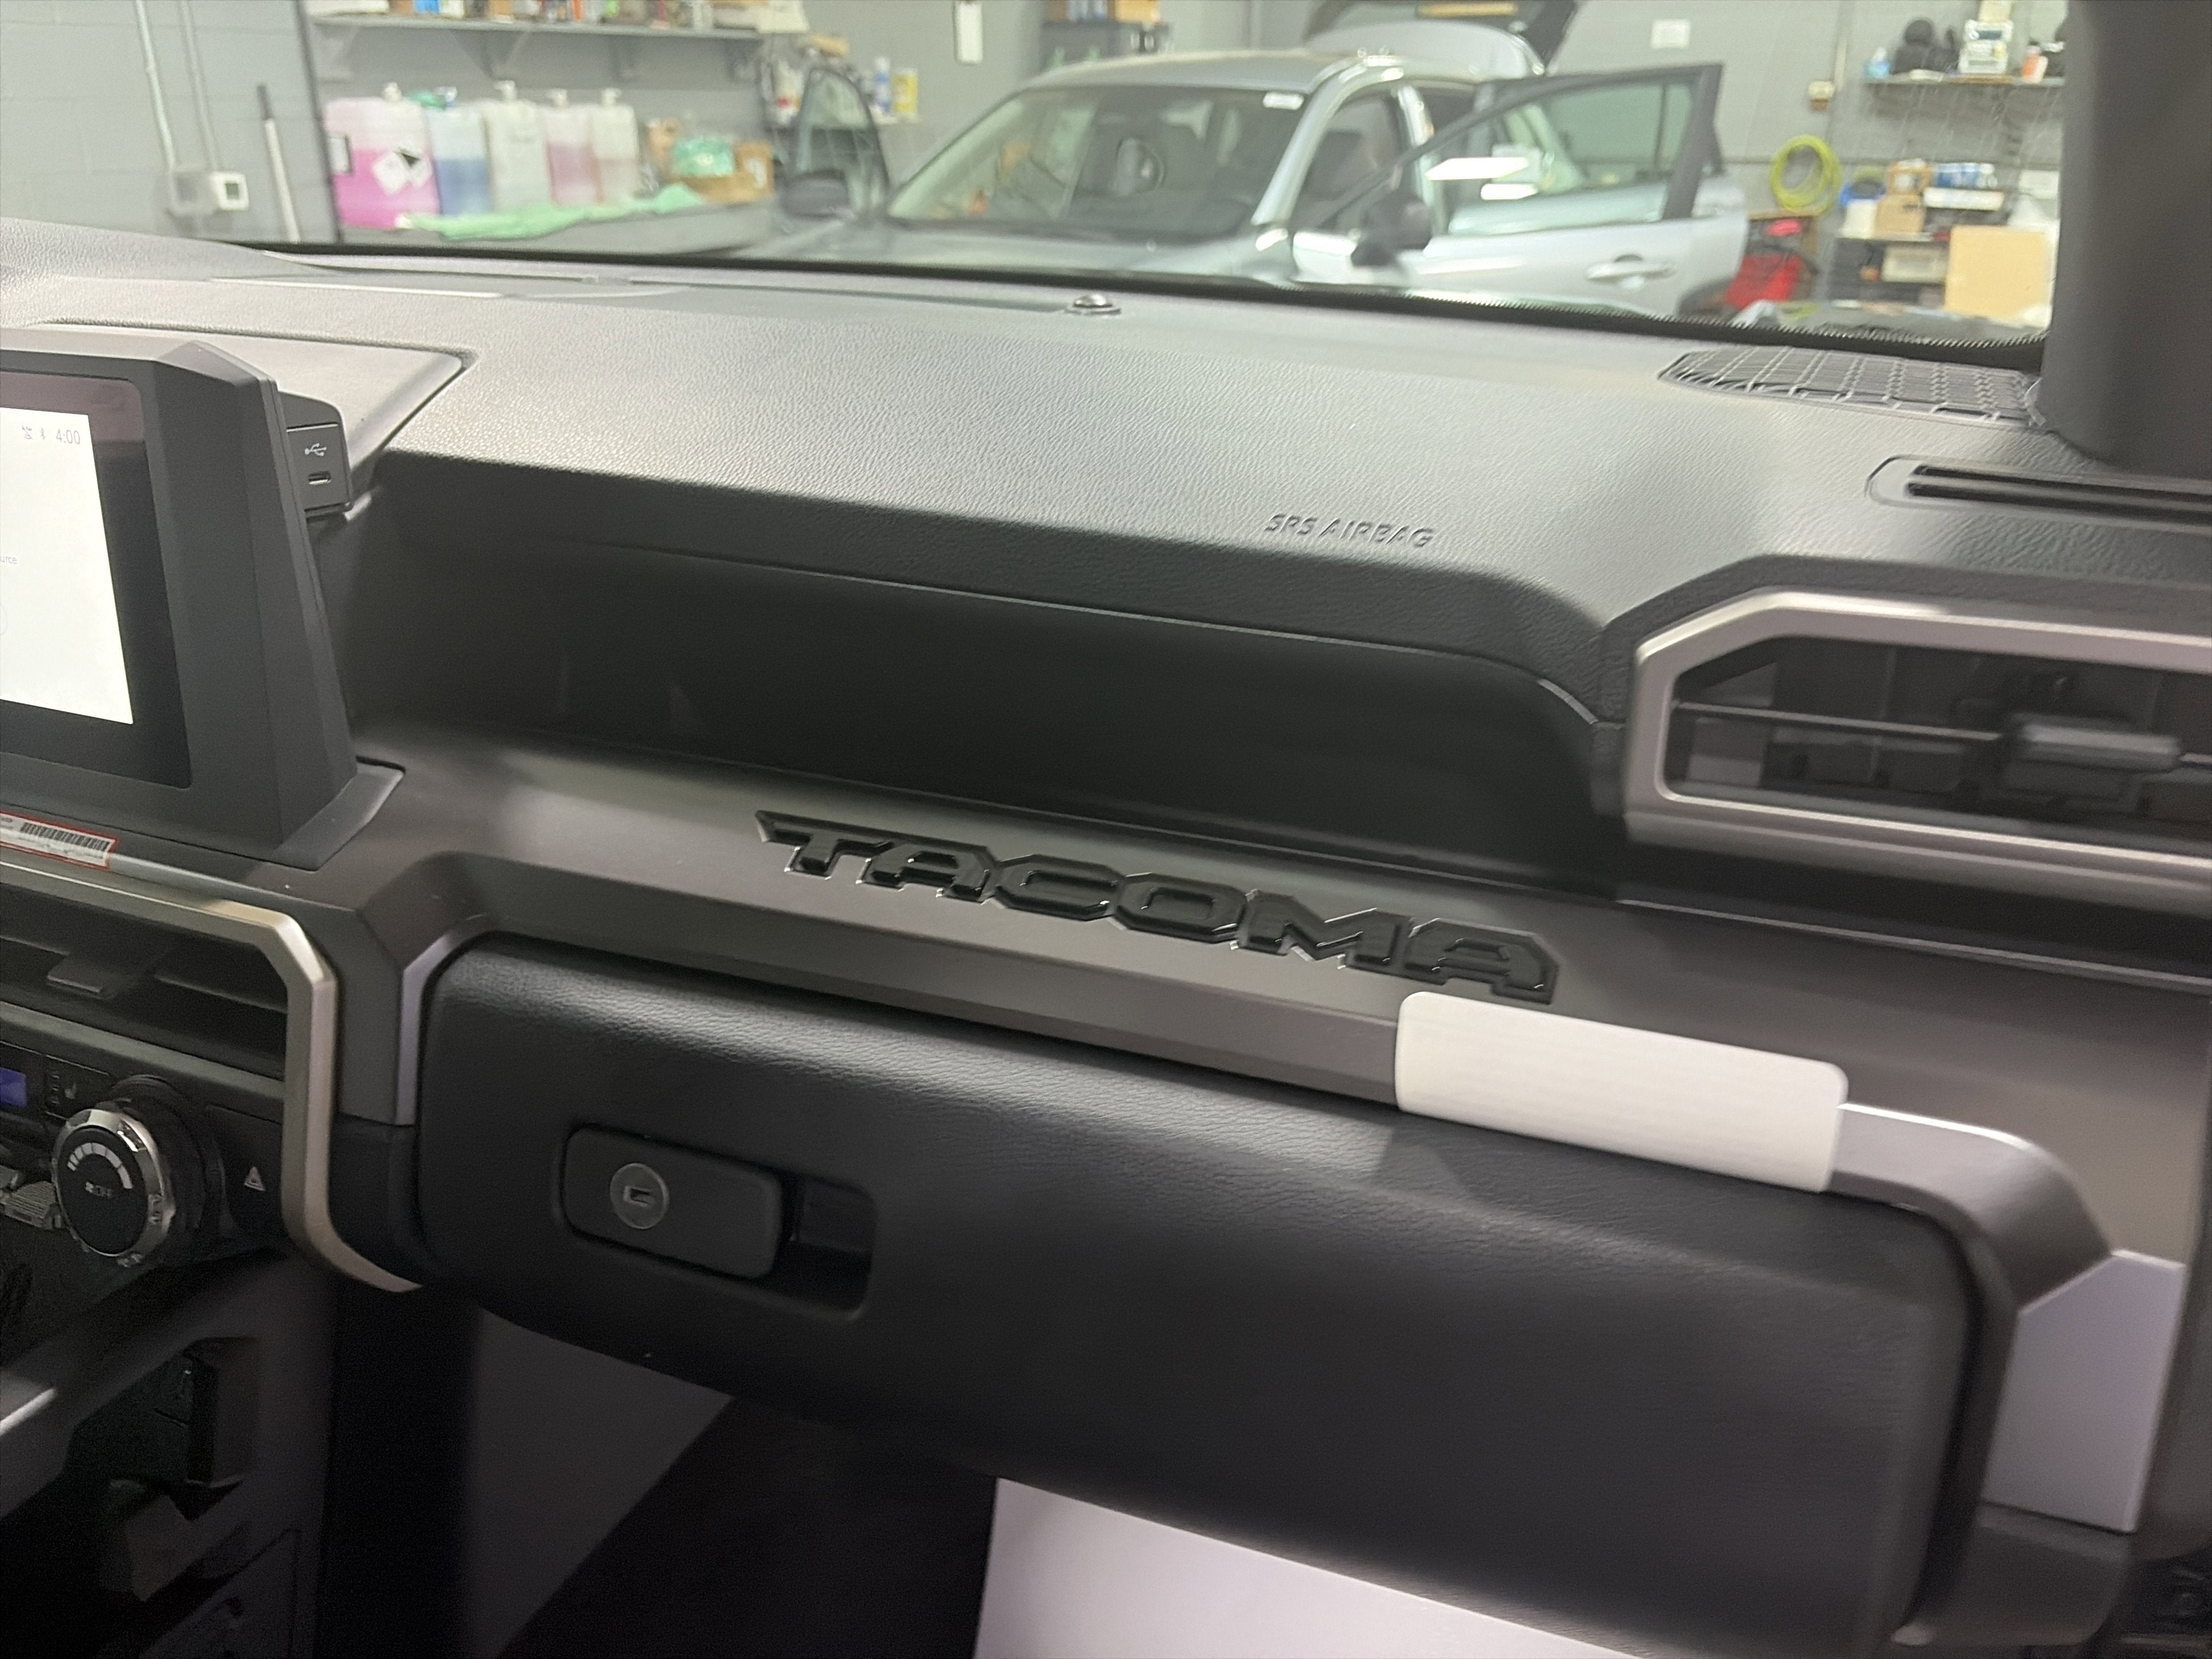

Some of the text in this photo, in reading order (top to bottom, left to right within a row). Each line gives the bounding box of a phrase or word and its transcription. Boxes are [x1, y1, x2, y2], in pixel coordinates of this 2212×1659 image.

[56, 428, 81, 444] 4:00
[1263, 514, 1434, 548] SRS AIRBAG
[754, 809, 1561, 1006] TACOMA
